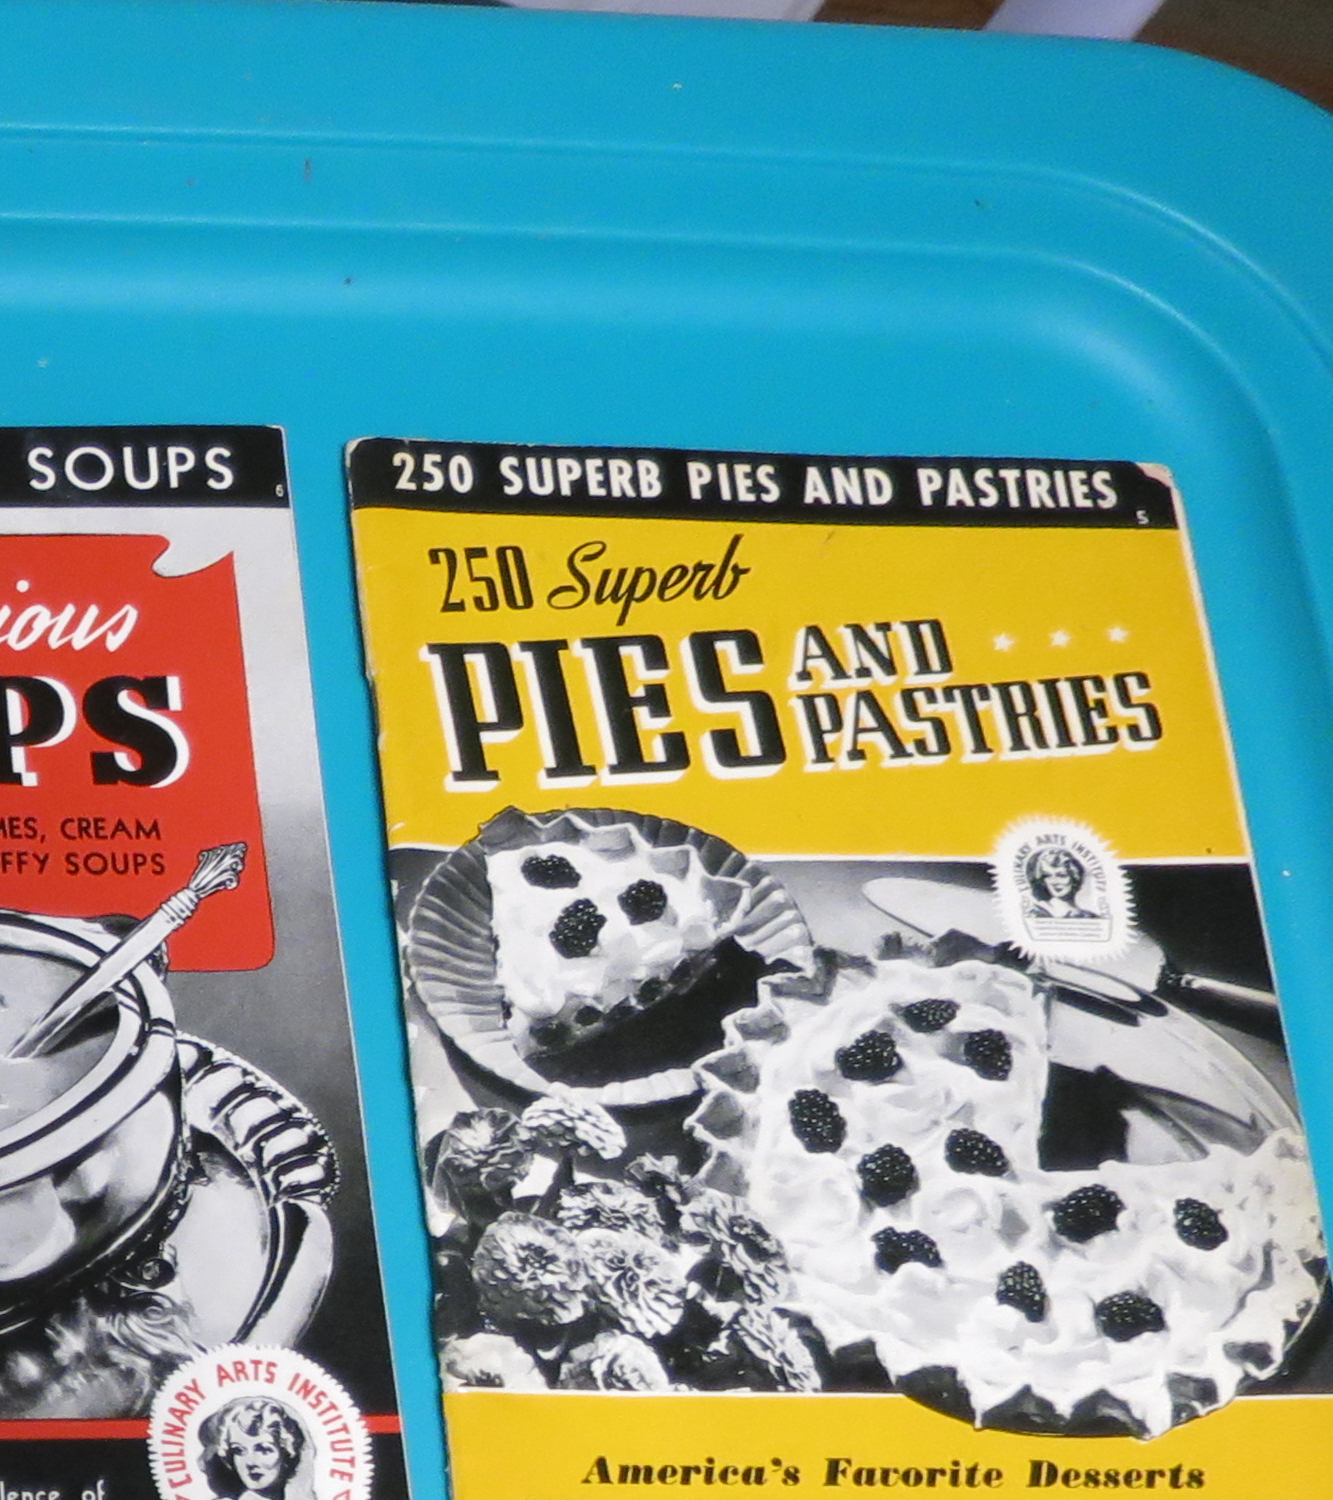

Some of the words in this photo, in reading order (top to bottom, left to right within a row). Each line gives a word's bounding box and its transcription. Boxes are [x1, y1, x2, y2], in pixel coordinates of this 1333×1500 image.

[27, 445, 234, 491] SOUPS
[392, 451, 474, 494] 250
[499, 456, 662, 498] SUPERB
[686, 460, 781, 504] PIES
[803, 466, 895, 506] AND
[917, 467, 1119, 509] PASTRIES
[428, 545, 535, 613] 250
[546, 533, 751, 627] Superb
[788, 618, 955, 692] AND
[418, 628, 788, 794] PIES
[792, 670, 1163, 773] PASTRIES
[59, 816, 162, 842] CREAM
[64, 851, 167, 877] SOUPS
[161, 1377, 207, 1489] CULINARY
[216, 1358, 279, 1388] ARTS
[286, 1371, 357, 1484] INSTITUTE
[580, 1454, 802, 1488] America's
[822, 1457, 1004, 1489] Favorite
[1026, 1458, 1206, 1491] Desserts
